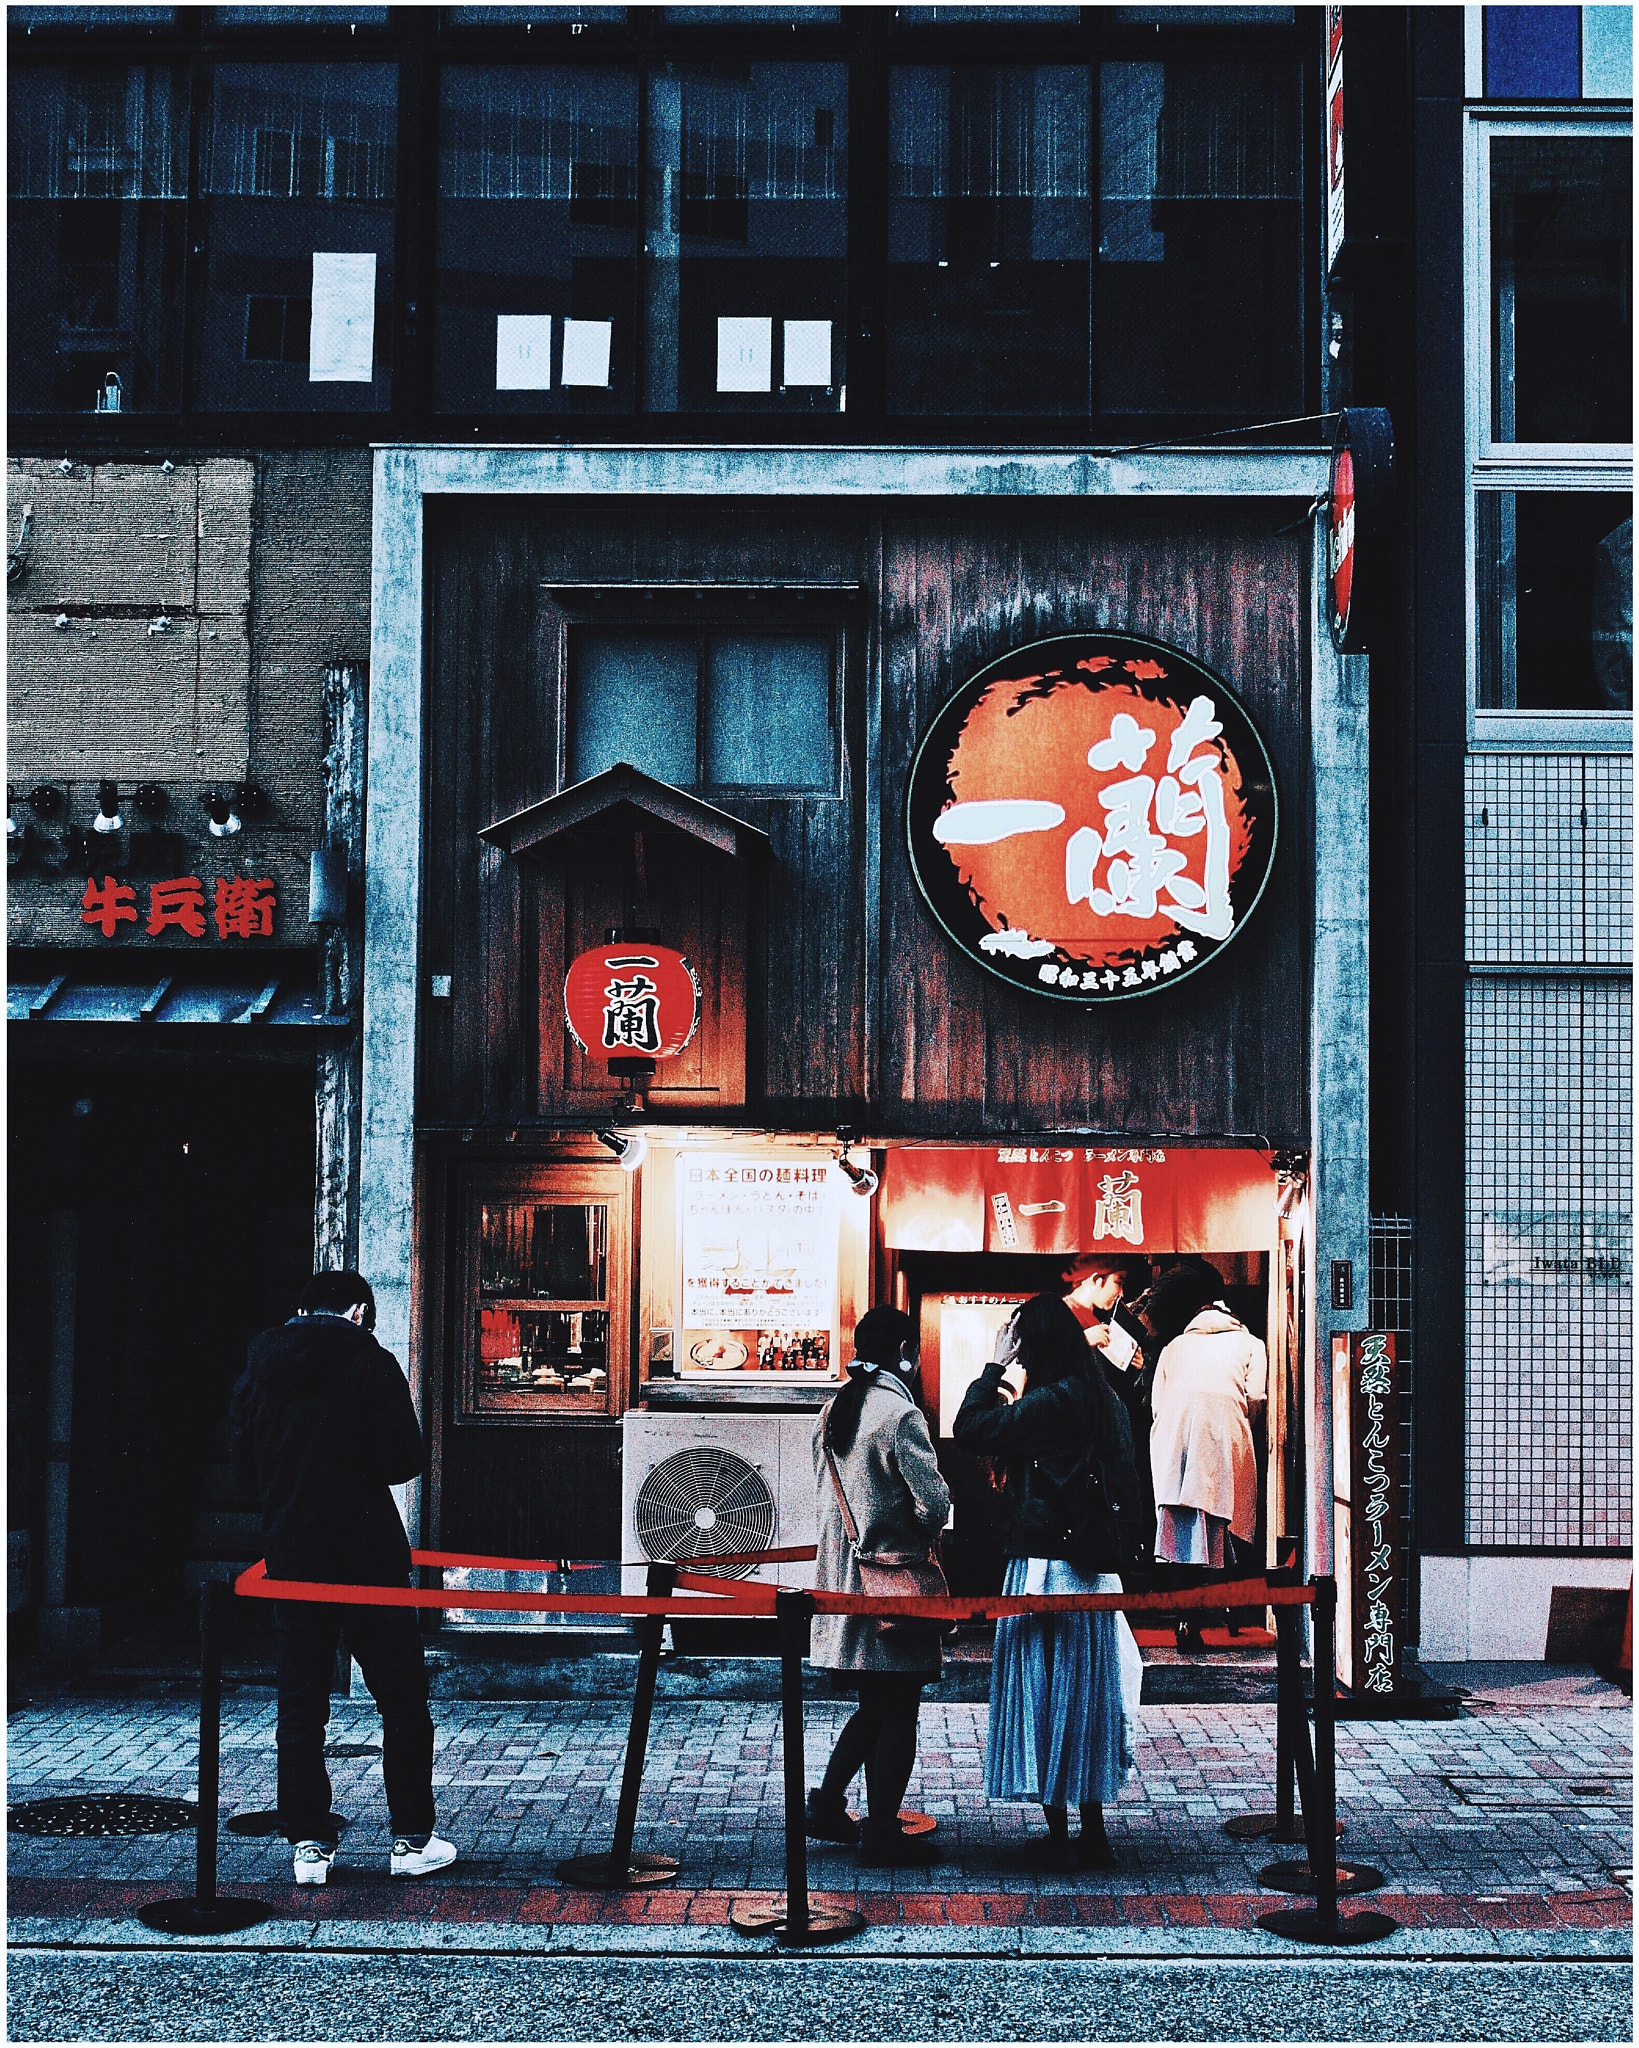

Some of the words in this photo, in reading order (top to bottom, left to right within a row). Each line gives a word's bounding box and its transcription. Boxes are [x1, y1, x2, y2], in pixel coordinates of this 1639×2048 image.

[932, 695, 1235, 941] 一蘭
[602, 955, 662, 1053] 一蘭
[689, 1167, 827, 1184] 日本全国の麺料理
[1018, 1170, 1144, 1246] 一蘭
[1534, 1256, 1578, 1270] Iwata
